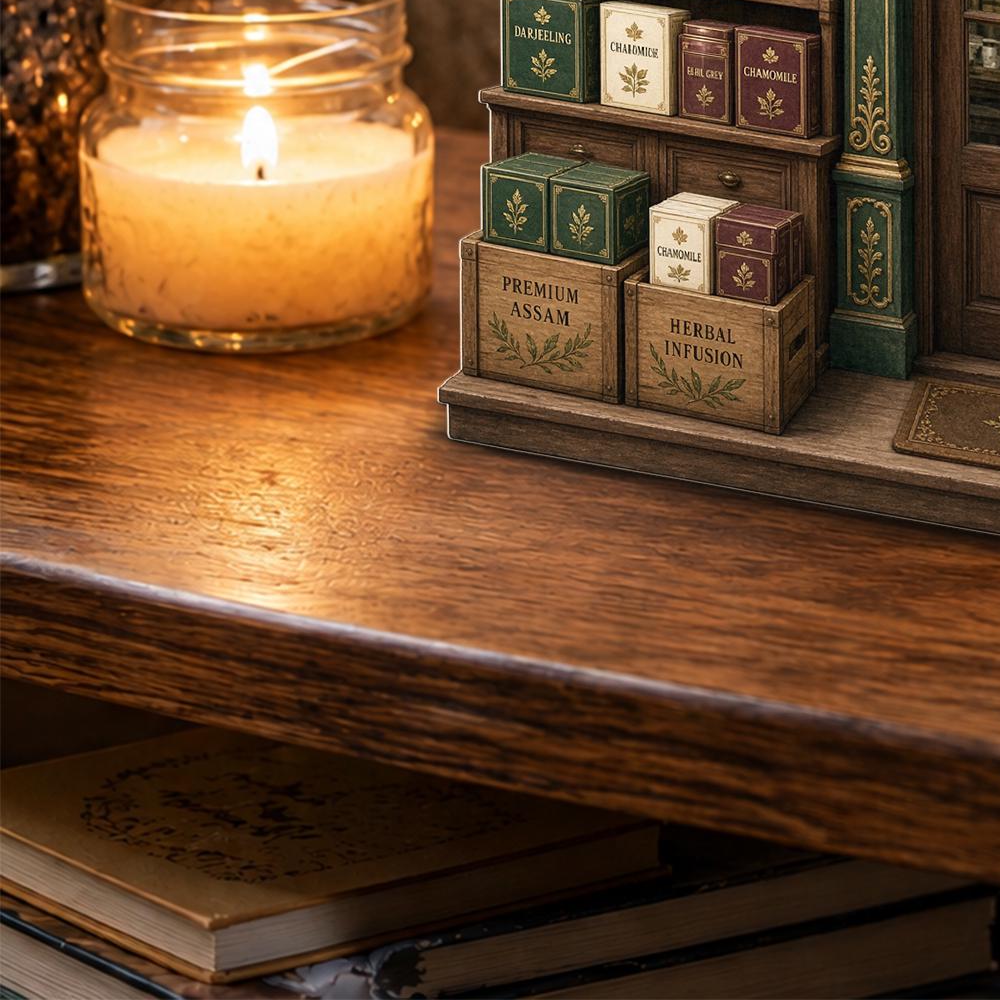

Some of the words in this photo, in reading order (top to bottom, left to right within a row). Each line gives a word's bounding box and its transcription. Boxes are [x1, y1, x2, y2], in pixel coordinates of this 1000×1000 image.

[514, 25, 572, 45] DARJEELING
[705, 69, 723, 81] GREY
[743, 66, 798, 84] CHAMOMILE
[657, 245, 702, 264] CHAMOMILE
[502, 276, 579, 305] PREMIUM
[510, 302, 570, 326] ASSAM
[670, 318, 736, 344] HERBAL
[665, 340, 743, 369] INFUSION
